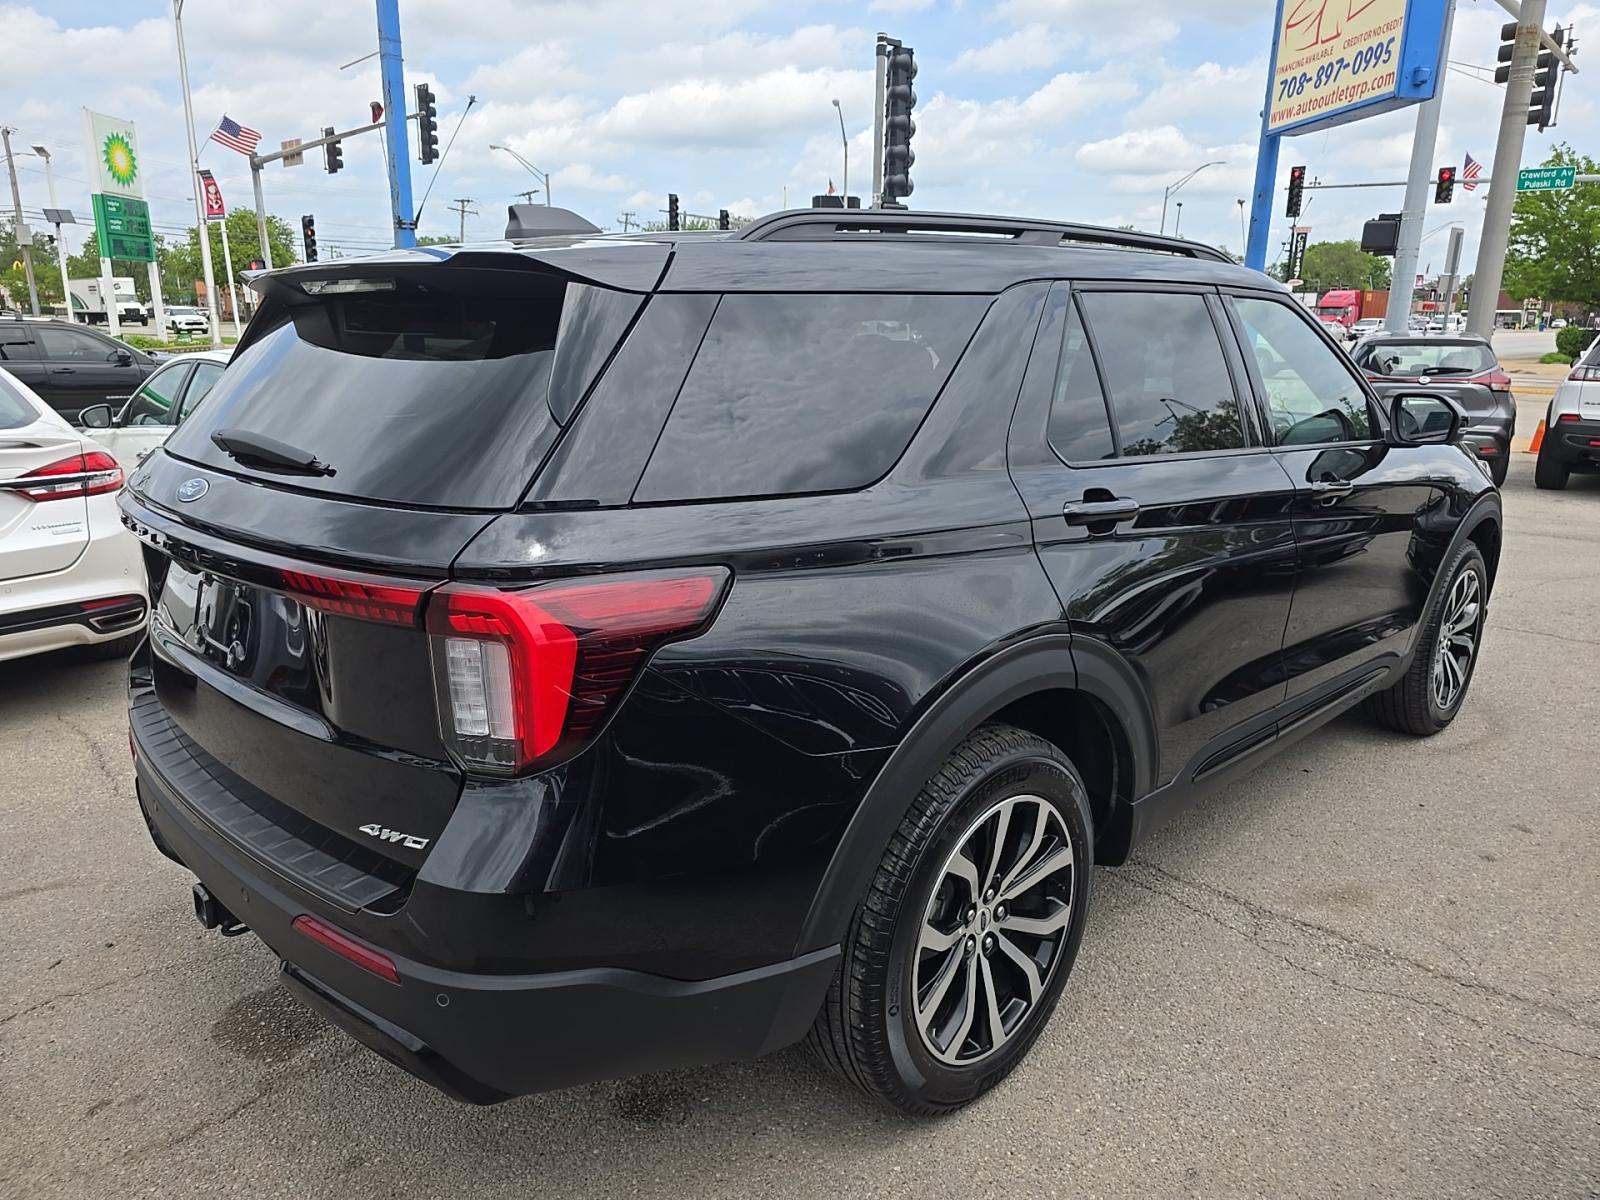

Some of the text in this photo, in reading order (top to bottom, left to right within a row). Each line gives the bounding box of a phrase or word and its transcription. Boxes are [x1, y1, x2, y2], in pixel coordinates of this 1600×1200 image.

[1343, 33, 1363, 50] CREDIT
[1382, 15, 1403, 34] CREDIT
[1276, 45, 1334, 76] FINANCING AVAILABLE
[1278, 36, 1396, 103] 708-897-0995
[1271, 71, 1395, 125] www.autooutletgrp.com
[1520, 169, 1573, 179] Crawford Av
[1523, 178, 1566, 188] Pulaski Rd
[358, 823, 430, 850] 4WD
